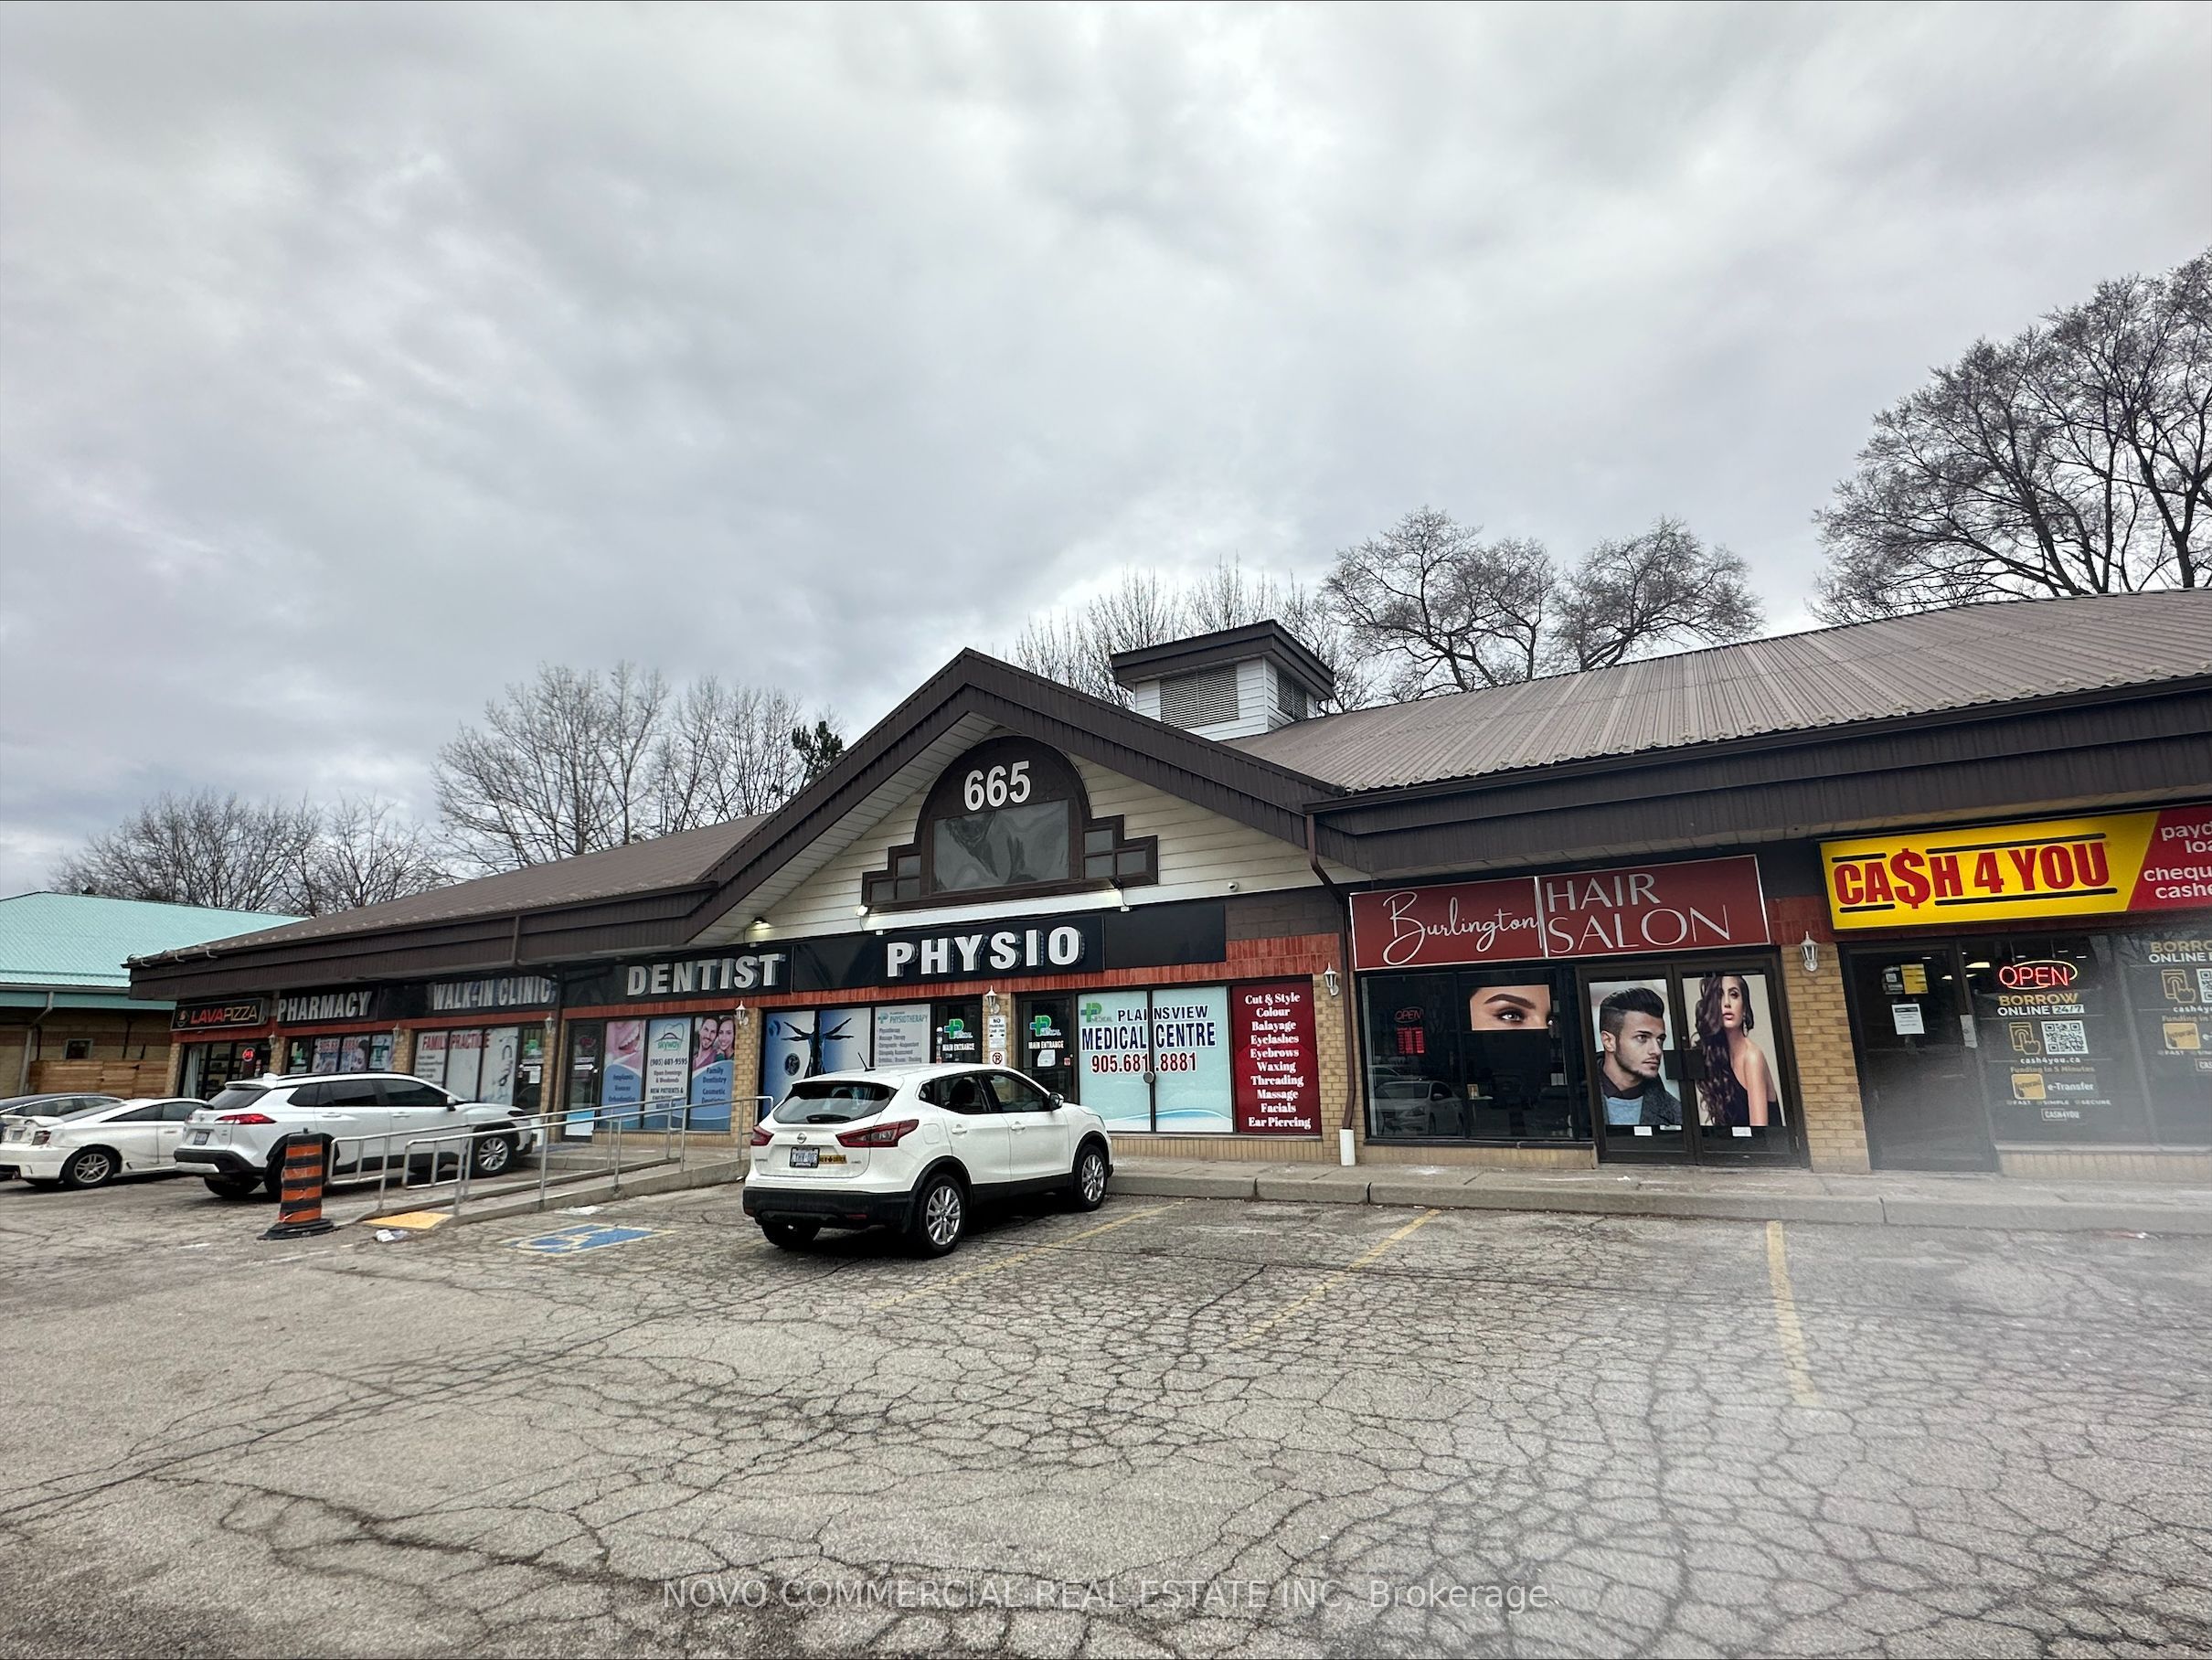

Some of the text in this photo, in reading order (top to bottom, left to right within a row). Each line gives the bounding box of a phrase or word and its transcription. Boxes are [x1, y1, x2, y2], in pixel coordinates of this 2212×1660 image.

[964, 761, 1031, 812] 665
[1834, 842, 2110, 910] CA$H 4 YOU
[2143, 866, 2212, 881] chequ
[1546, 873, 1661, 912] HAIR
[1382, 891, 1538, 965] Burlington
[1547, 904, 1732, 953] SALON
[887, 926, 1082, 977] PHYSIO
[2148, 952, 2207, 963] ONLINE
[627, 953, 781, 996] DENTIST
[1999, 966, 2068, 986] OPEN
[433, 975, 550, 1010] WALK-IN CLINIC
[1245, 992, 1301, 1006] Cut & Style
[1998, 993, 2079, 1006] BORROW
[277, 991, 372, 1022] PHARMACY
[1256, 1006, 1291, 1017] Colour
[1997, 1006, 2050, 1016] ONLINE
[1118, 1006, 1208, 1022] PLAINSVIEW
[1395, 1009, 1420, 1020] OPEN
[1251, 1020, 1296, 1033] Balayage
[1082, 1022, 1216, 1050] MEDICAL CENTRE
[1250, 1033, 1299, 1047] Eyelashes
[1250, 1048, 1299, 1060] Eyebrows
[2020, 1057, 2081, 1065] cash4you.ca
[1257, 1061, 1296, 1073] Waxing
[1250, 1075, 1304, 1088] Threading
[2047, 1081, 2094, 1091] e-Transfer
[1257, 1089, 1299, 1101] Massage
[1260, 1102, 1296, 1113] Facials
[1248, 1116, 1312, 1130] Ear Piercing
